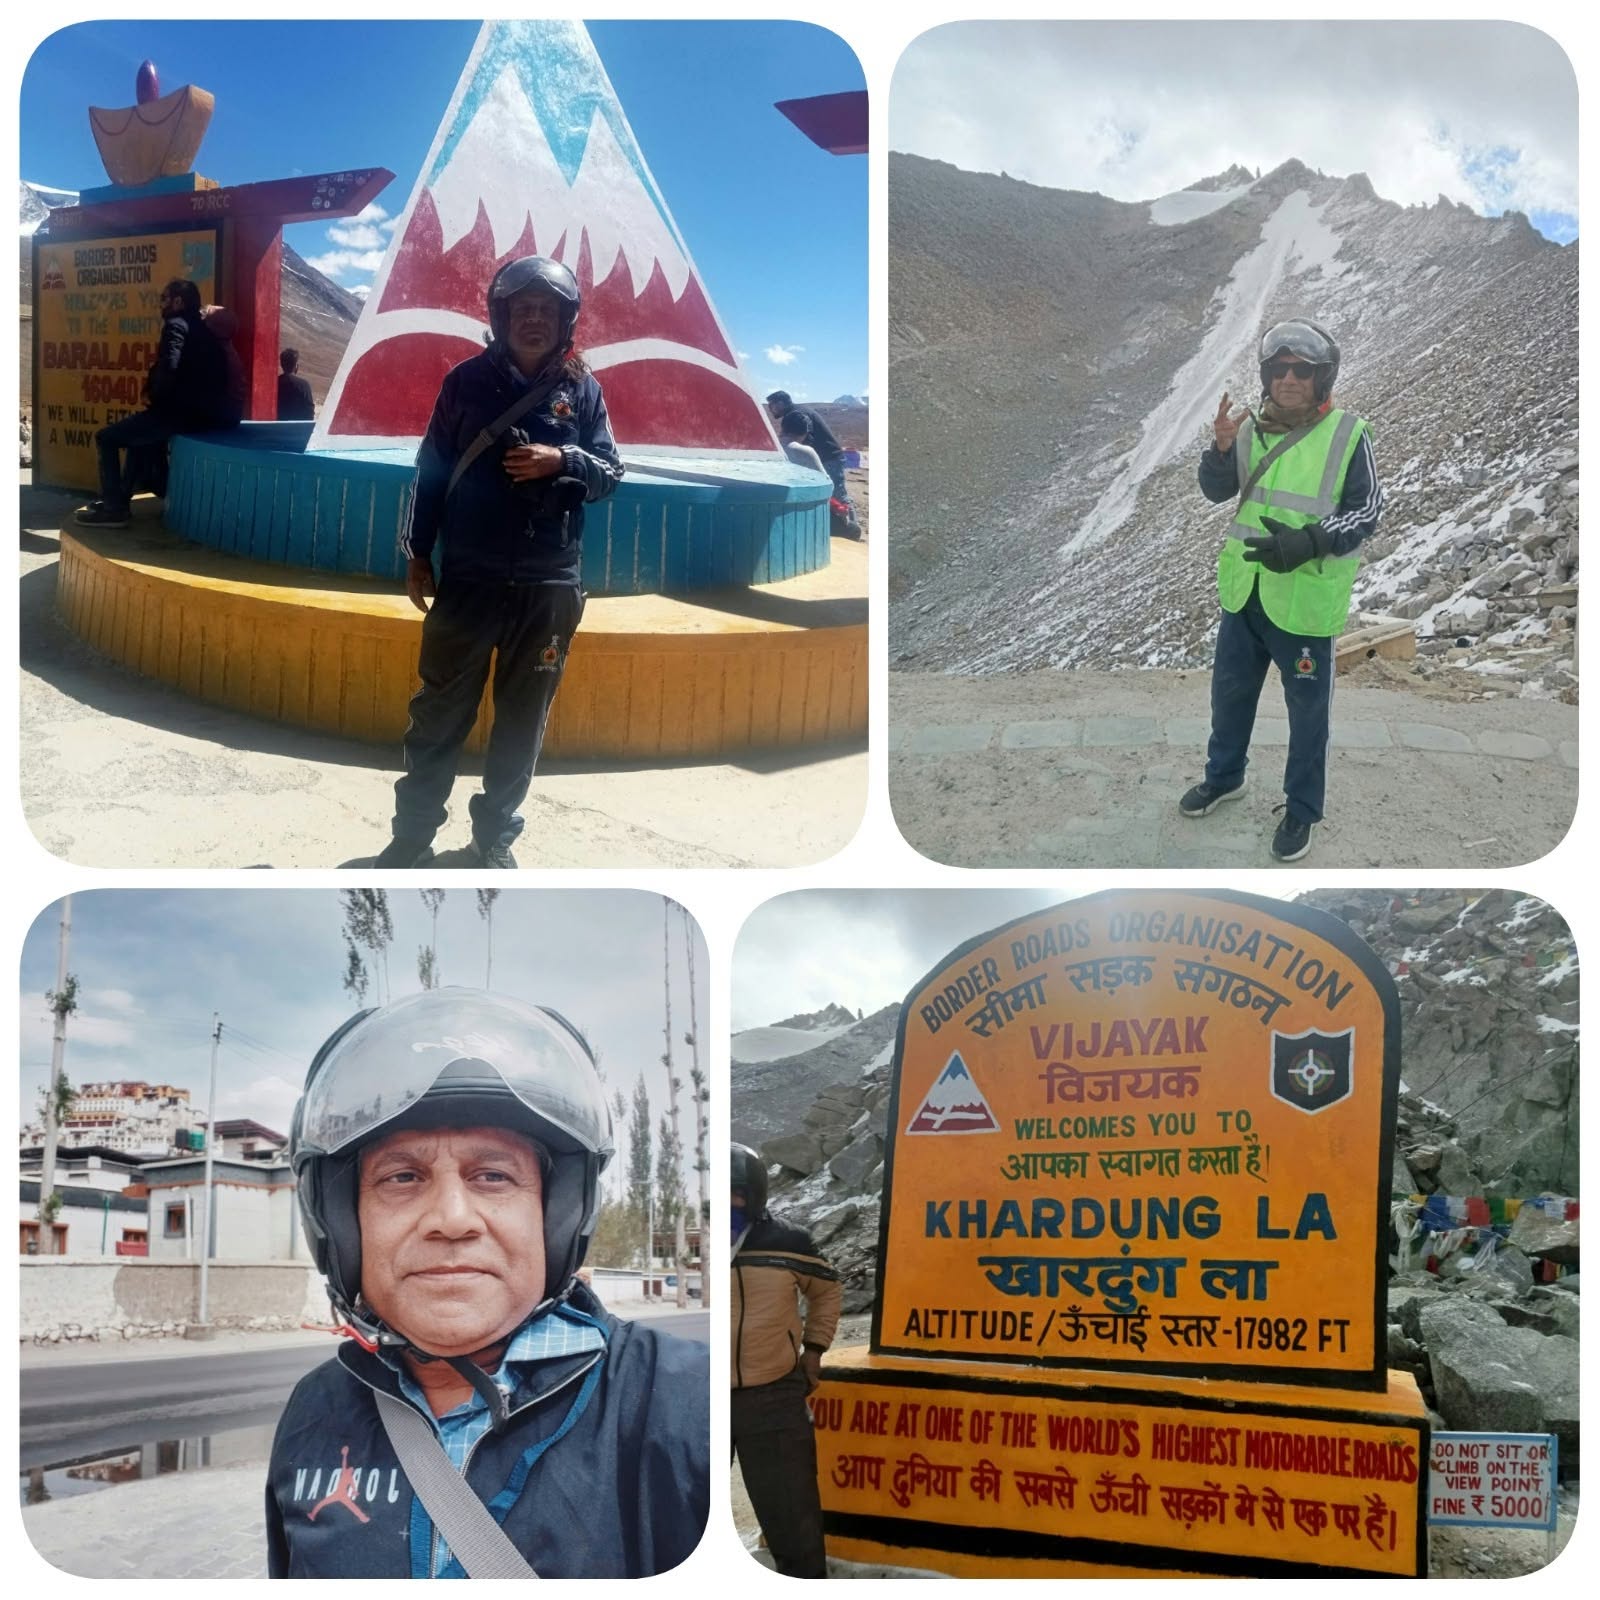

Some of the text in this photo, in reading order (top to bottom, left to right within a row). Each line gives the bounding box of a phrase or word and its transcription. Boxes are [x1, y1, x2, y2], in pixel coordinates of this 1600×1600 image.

[74, 244, 157, 267] BORDER ROADS
[77, 265, 152, 286] ORGANISATION
[43, 341, 159, 371] BARALACH
[68, 405, 99, 425] WILL
[49, 427, 93, 448] A WAY
[920, 910, 1354, 1034] BORDER ROADS ORGANISATION
[964, 954, 1293, 1037] सीमा सड़क संगठन
[1030, 1016, 1210, 1060] VIJAYAK
[1039, 1062, 1202, 1104] विजयक
[1014, 1109, 1251, 1140] WELCOMES YOU TO
[1000, 1151, 1090, 1181] आपका
[1098, 1148, 1182, 1179] स्वागत
[1188, 1145, 1242, 1176] करता
[925, 1193, 1338, 1241] KHARDUNG LA
[977, 1243, 1279, 1313] खारदुंग ला
[1318, 1318, 1350, 1353] FT
[850, 1400, 890, 1435] ARE
[894, 1403, 920, 1438] AT
[925, 1404, 963, 1442] ONE
[969, 1409, 995, 1444] OF
[1000, 1411, 1037, 1448] THE
[1047, 1414, 1140, 1458] WORLD'S
[1152, 1423, 1241, 1466] HIGHEST
[1245, 1429, 1352, 1478] MOTORABLE
[1353, 1439, 1419, 1484] ROADS
[1435, 1443, 1548, 1460] DO NOT SIT OR
[1437, 1460, 1539, 1476] CLIMB ON THE
[1445, 1476, 1544, 1492] VIEW POINT
[832, 1455, 886, 1490] आप
[889, 1453, 963, 1508] दुनिया
[970, 1459, 1002, 1504] की
[1014, 1466, 1078, 1510] सबसे
[1089, 1470, 1151, 1517] ऊँची
[1261, 1486, 1285, 1531] से
[1290, 1498, 1328, 1537] एक
[1331, 1503, 1361, 1540] पर
[1433, 1497, 1465, 1515] FINE
